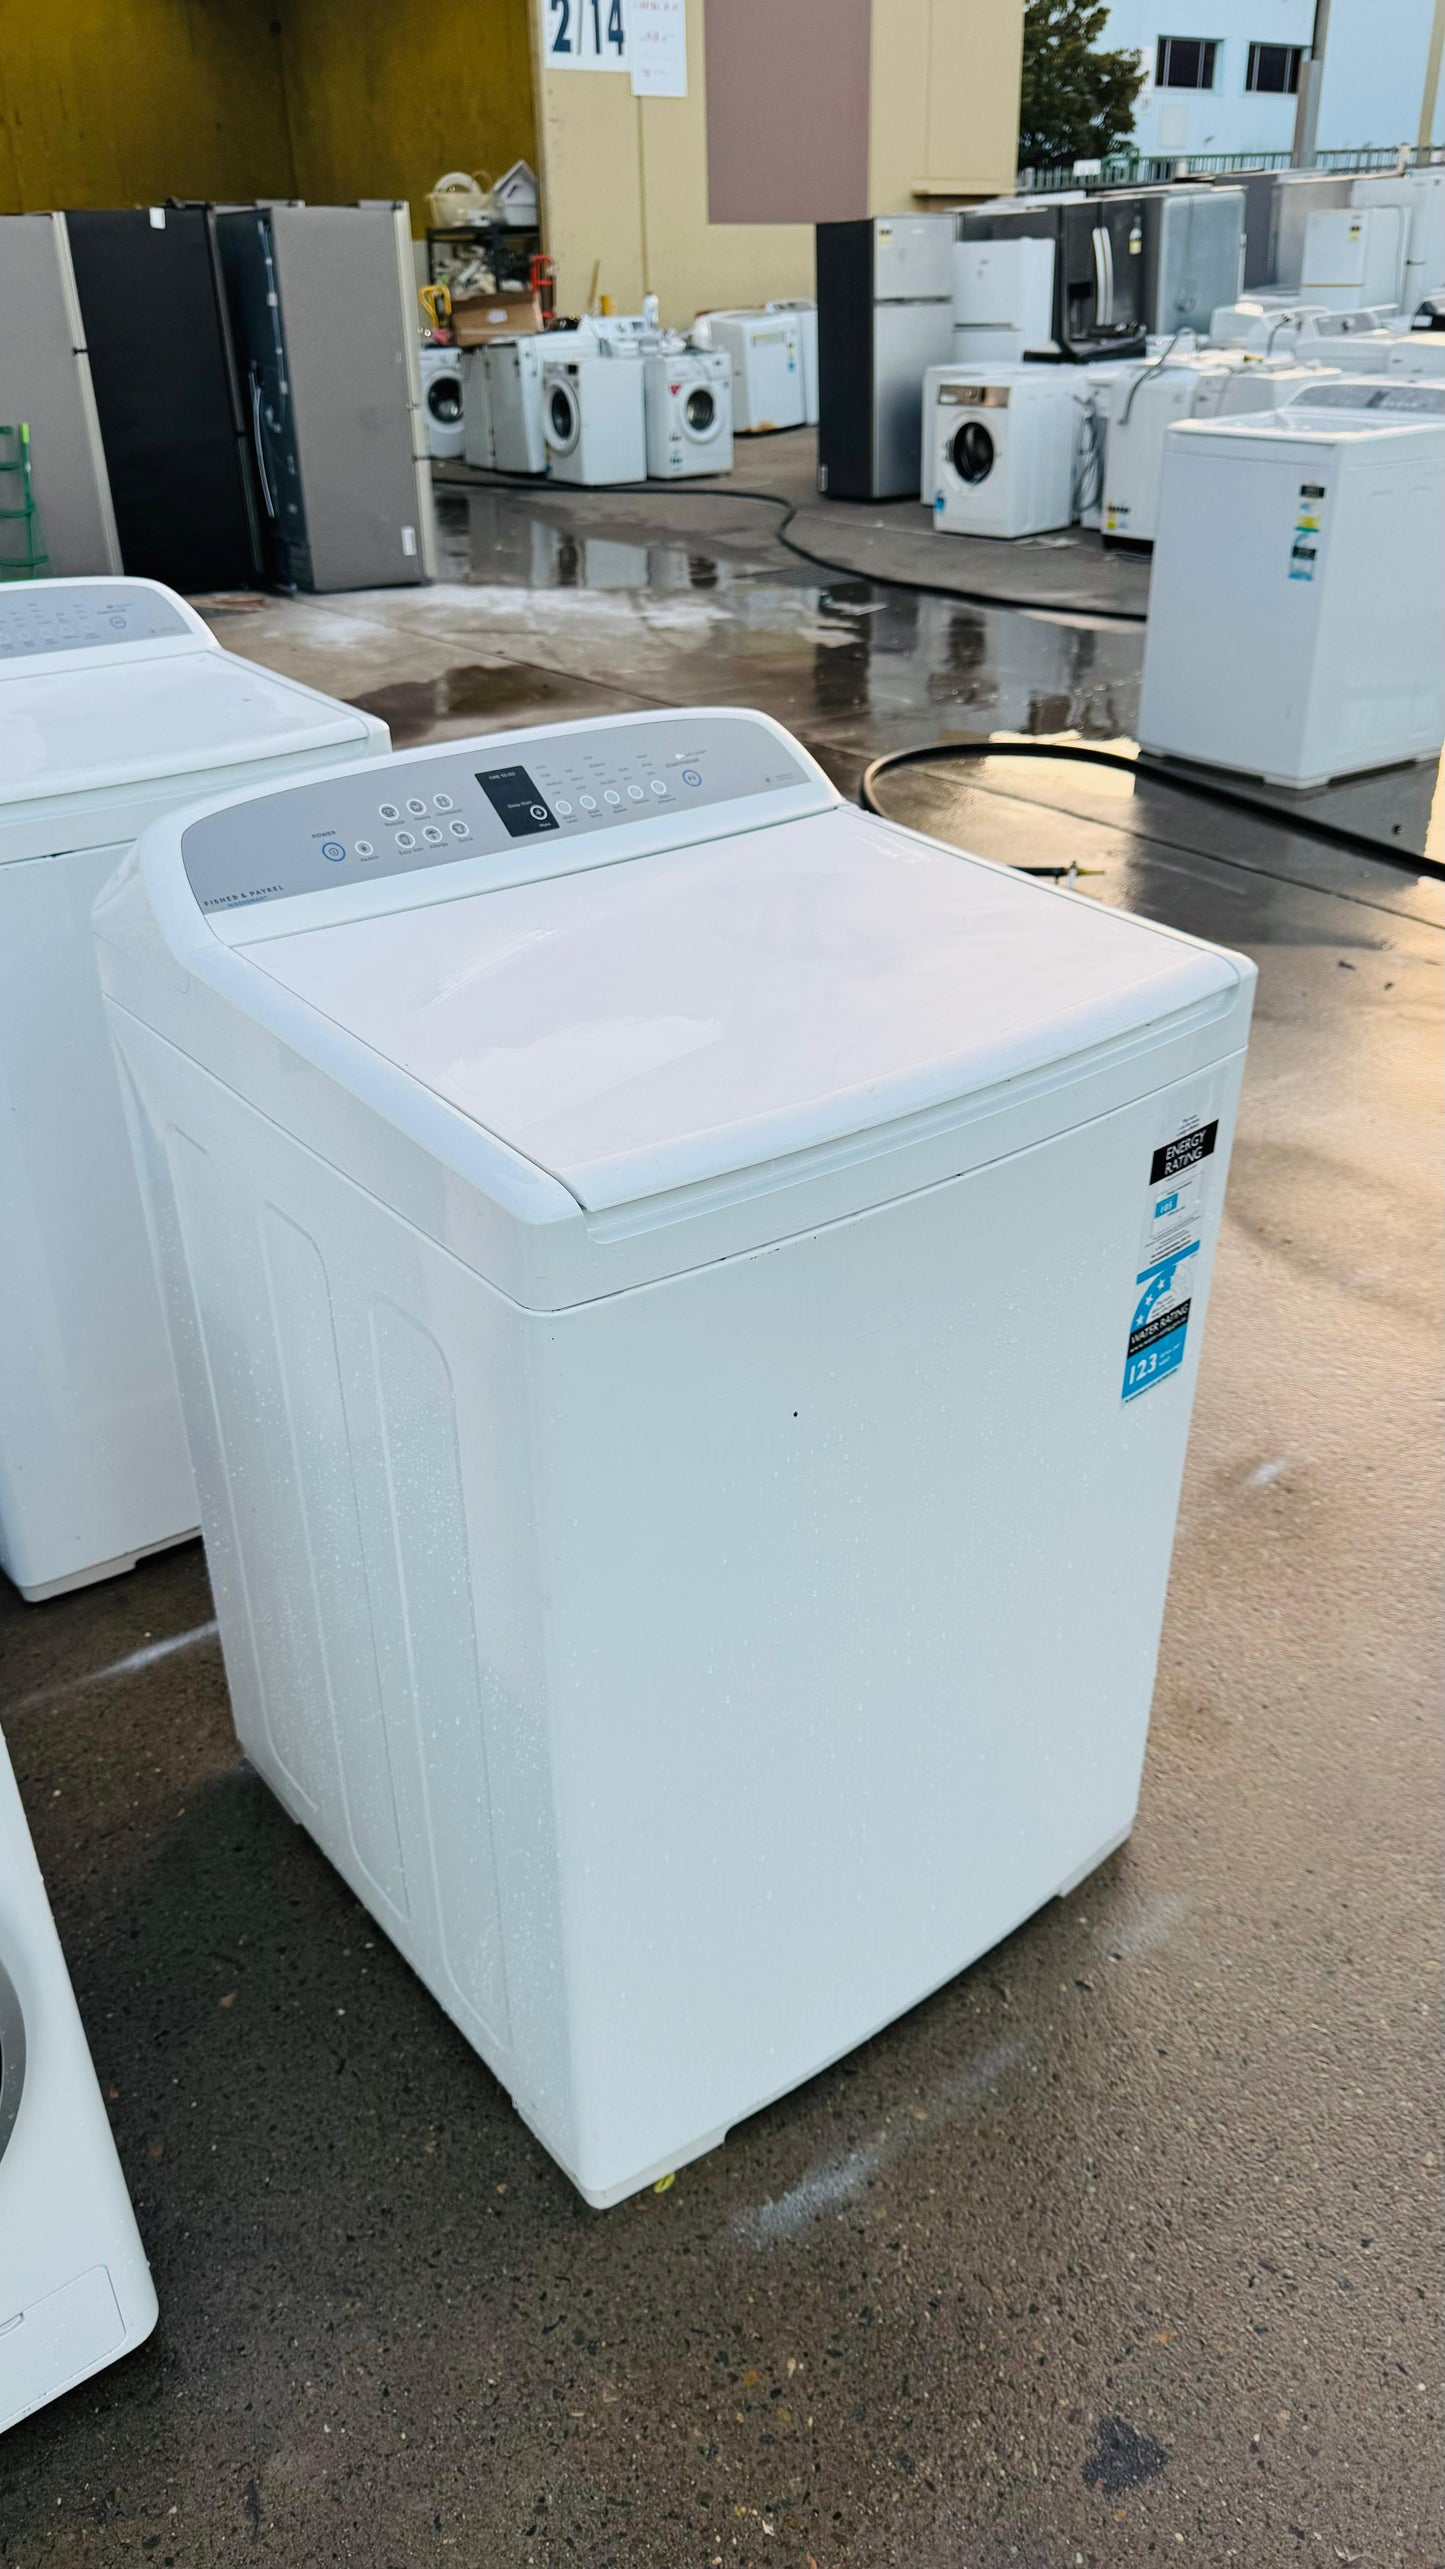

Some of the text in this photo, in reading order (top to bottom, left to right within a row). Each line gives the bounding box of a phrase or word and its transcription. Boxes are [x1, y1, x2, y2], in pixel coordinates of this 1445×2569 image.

[311, 830, 337, 840] POWER
[204, 895, 239, 906] FISHER
[249, 885, 285, 897] PAYKEL
[1165, 1129, 1207, 1161] ENERGY
[1164, 1146, 1204, 1175] RATING
[1131, 1322, 1160, 1344] WATER
[1160, 1303, 1190, 1327] RATING
[1128, 1353, 1158, 1385] 123
